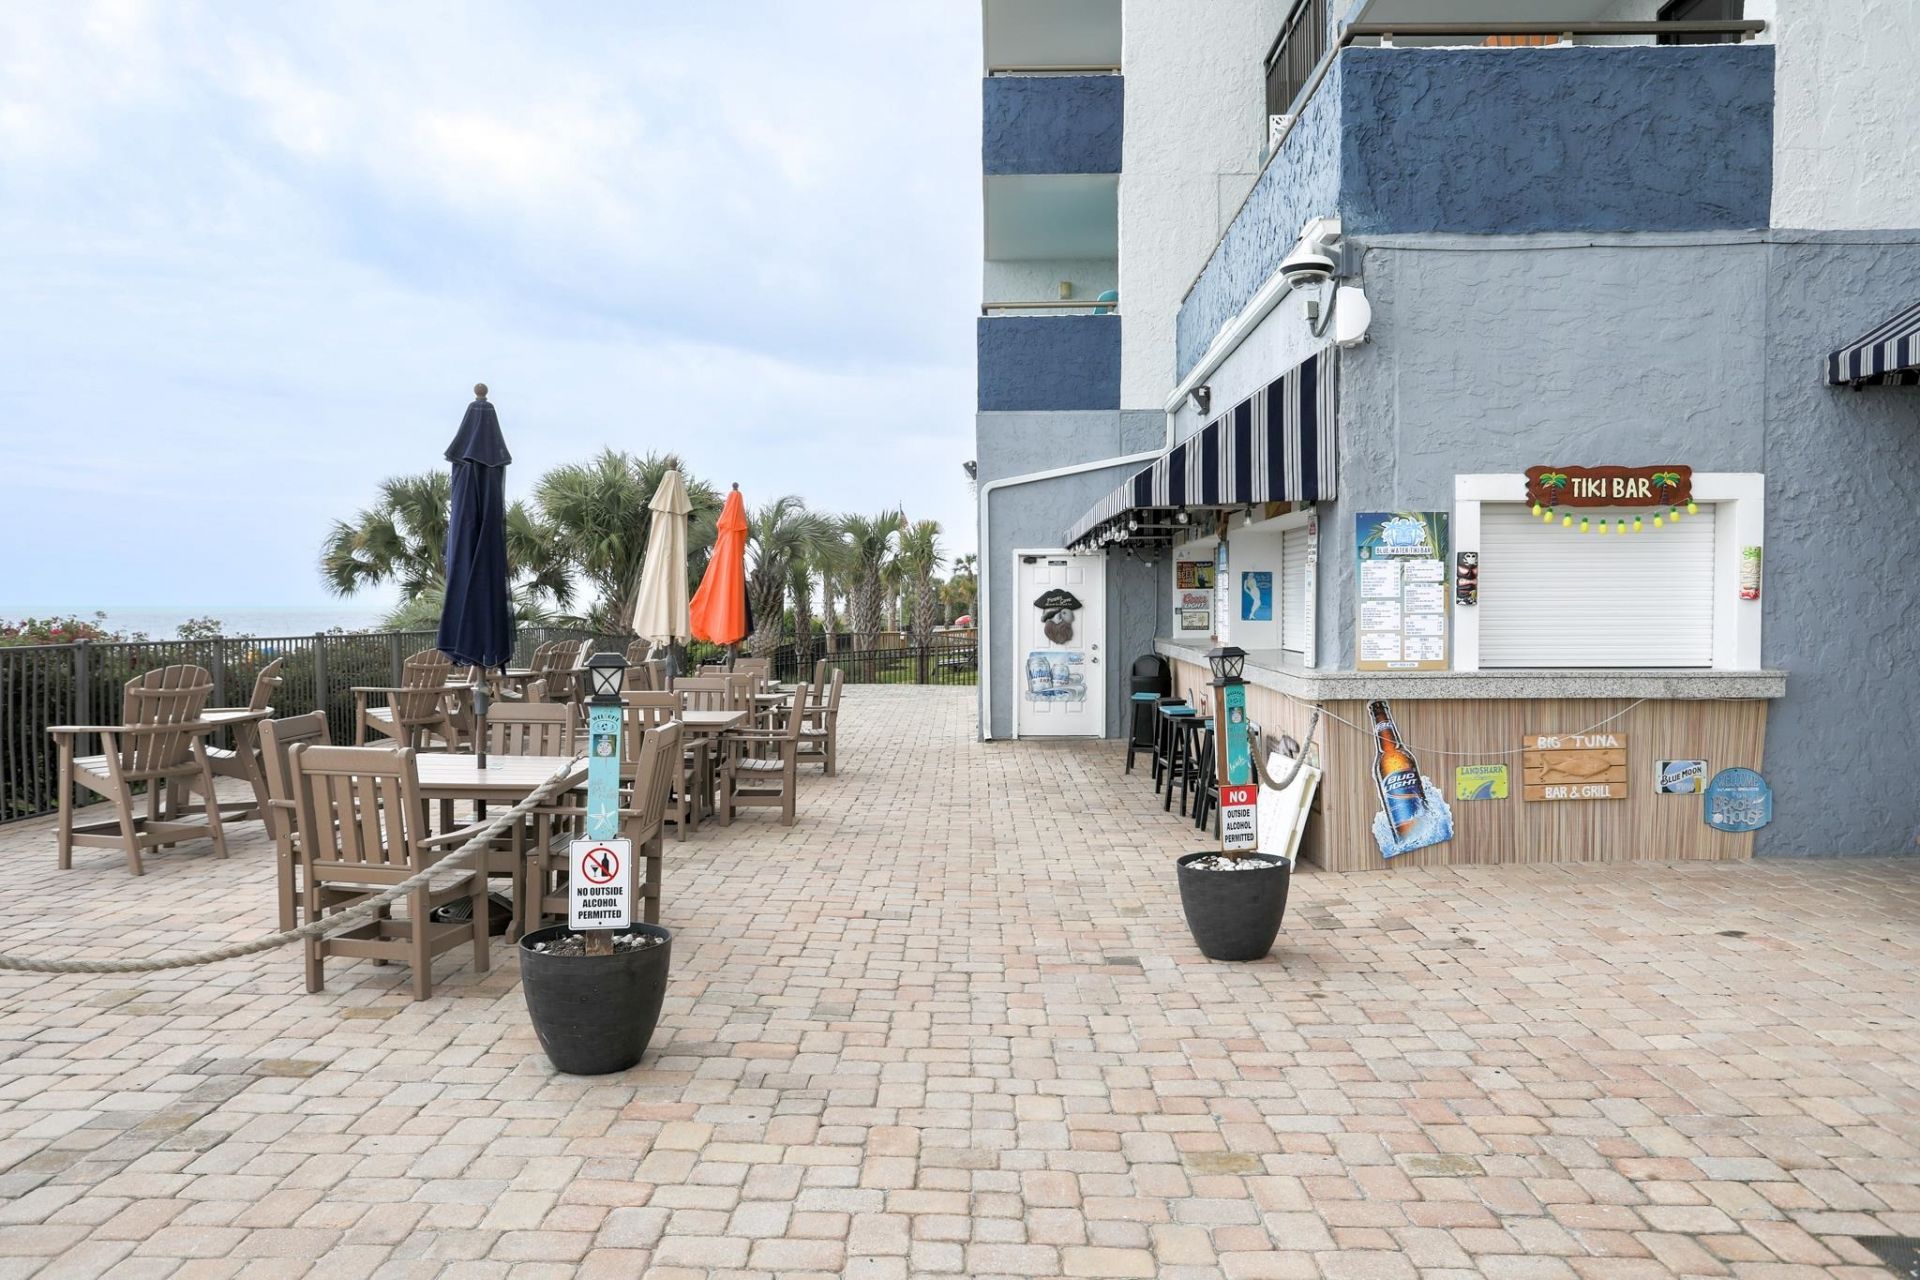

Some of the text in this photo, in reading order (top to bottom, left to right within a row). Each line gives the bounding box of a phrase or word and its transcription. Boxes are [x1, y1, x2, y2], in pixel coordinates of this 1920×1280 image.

[1571, 478, 1652, 499] TIKI BAR
[1537, 735, 1619, 749] BIG TUNA
[1460, 766, 1503, 775] LANDSHARK
[1660, 766, 1702, 786] BLUE MOON
[1384, 778, 1417, 791] LIGHT
[1387, 772, 1415, 785] BUD
[1229, 790, 1248, 803] NO
[1545, 784, 1612, 799] BAR & GRILL
[1227, 808, 1251, 818] OUTSIDE
[1226, 821, 1252, 831] ALCOHOL
[1224, 832, 1255, 843] PERMITTED
[576, 886, 624, 897] NO OUTSIDE
[582, 898, 618, 908] ALCOHOL
[577, 909, 622, 920] PERMITTED
